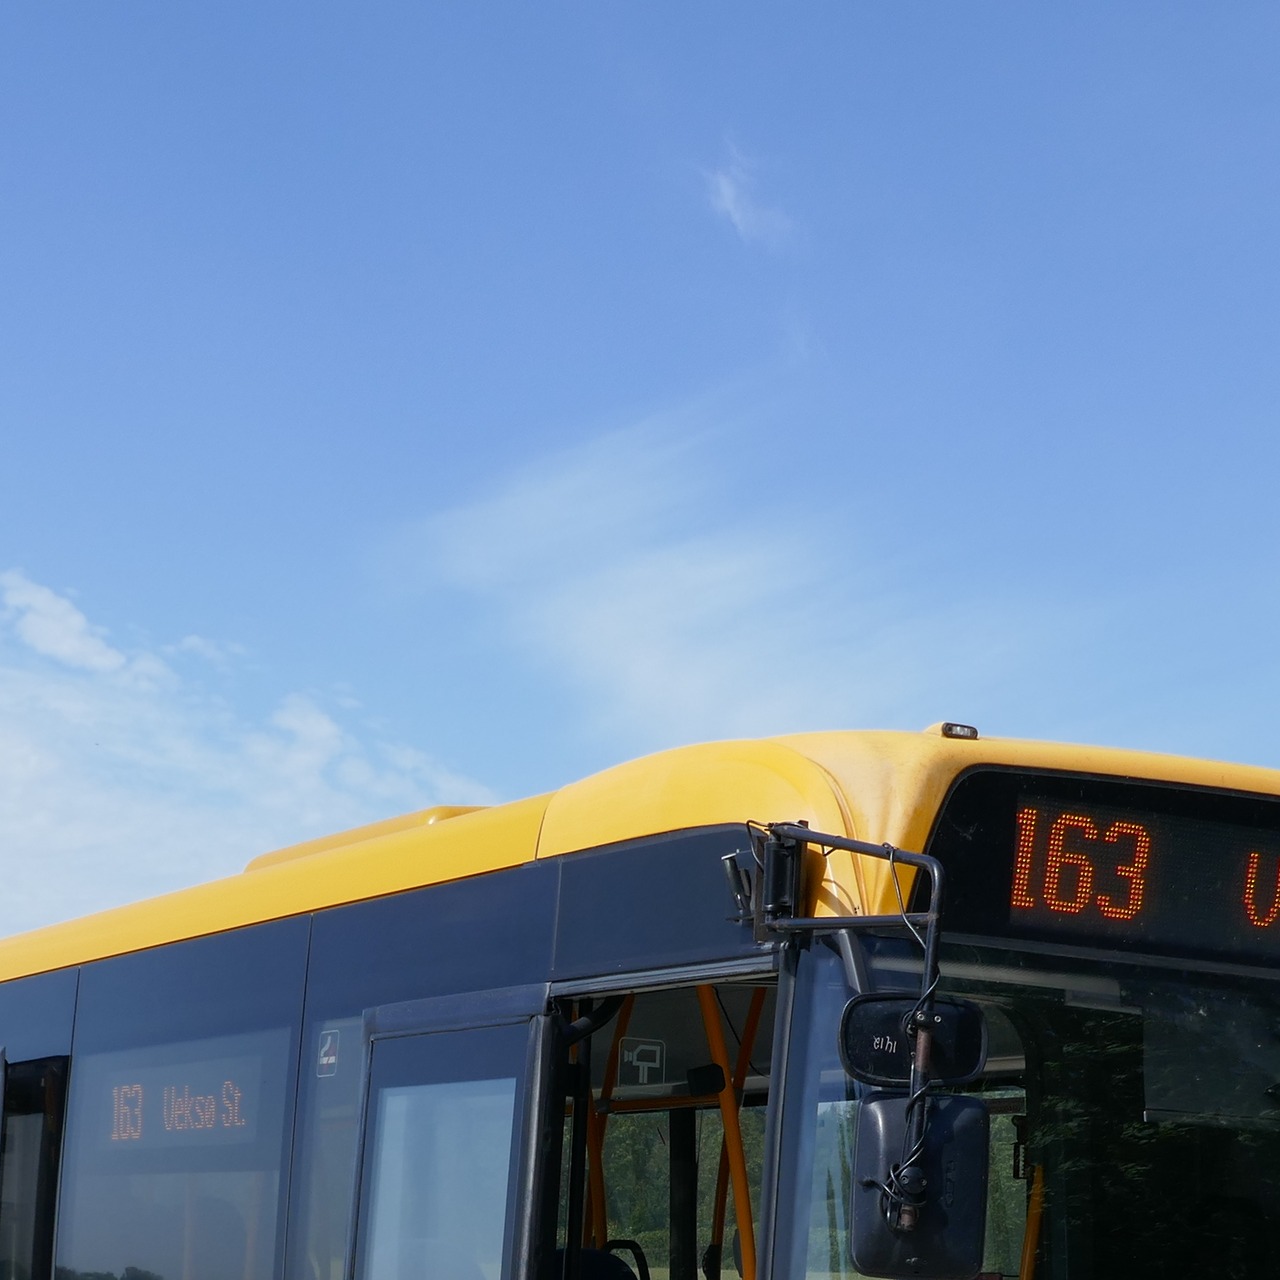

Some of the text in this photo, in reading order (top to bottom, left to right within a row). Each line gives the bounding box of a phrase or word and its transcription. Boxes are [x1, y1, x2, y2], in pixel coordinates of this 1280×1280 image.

[1012, 808, 1150, 920] 163
[111, 1084, 143, 1140] 163
[221, 1080, 246, 1127] St.
